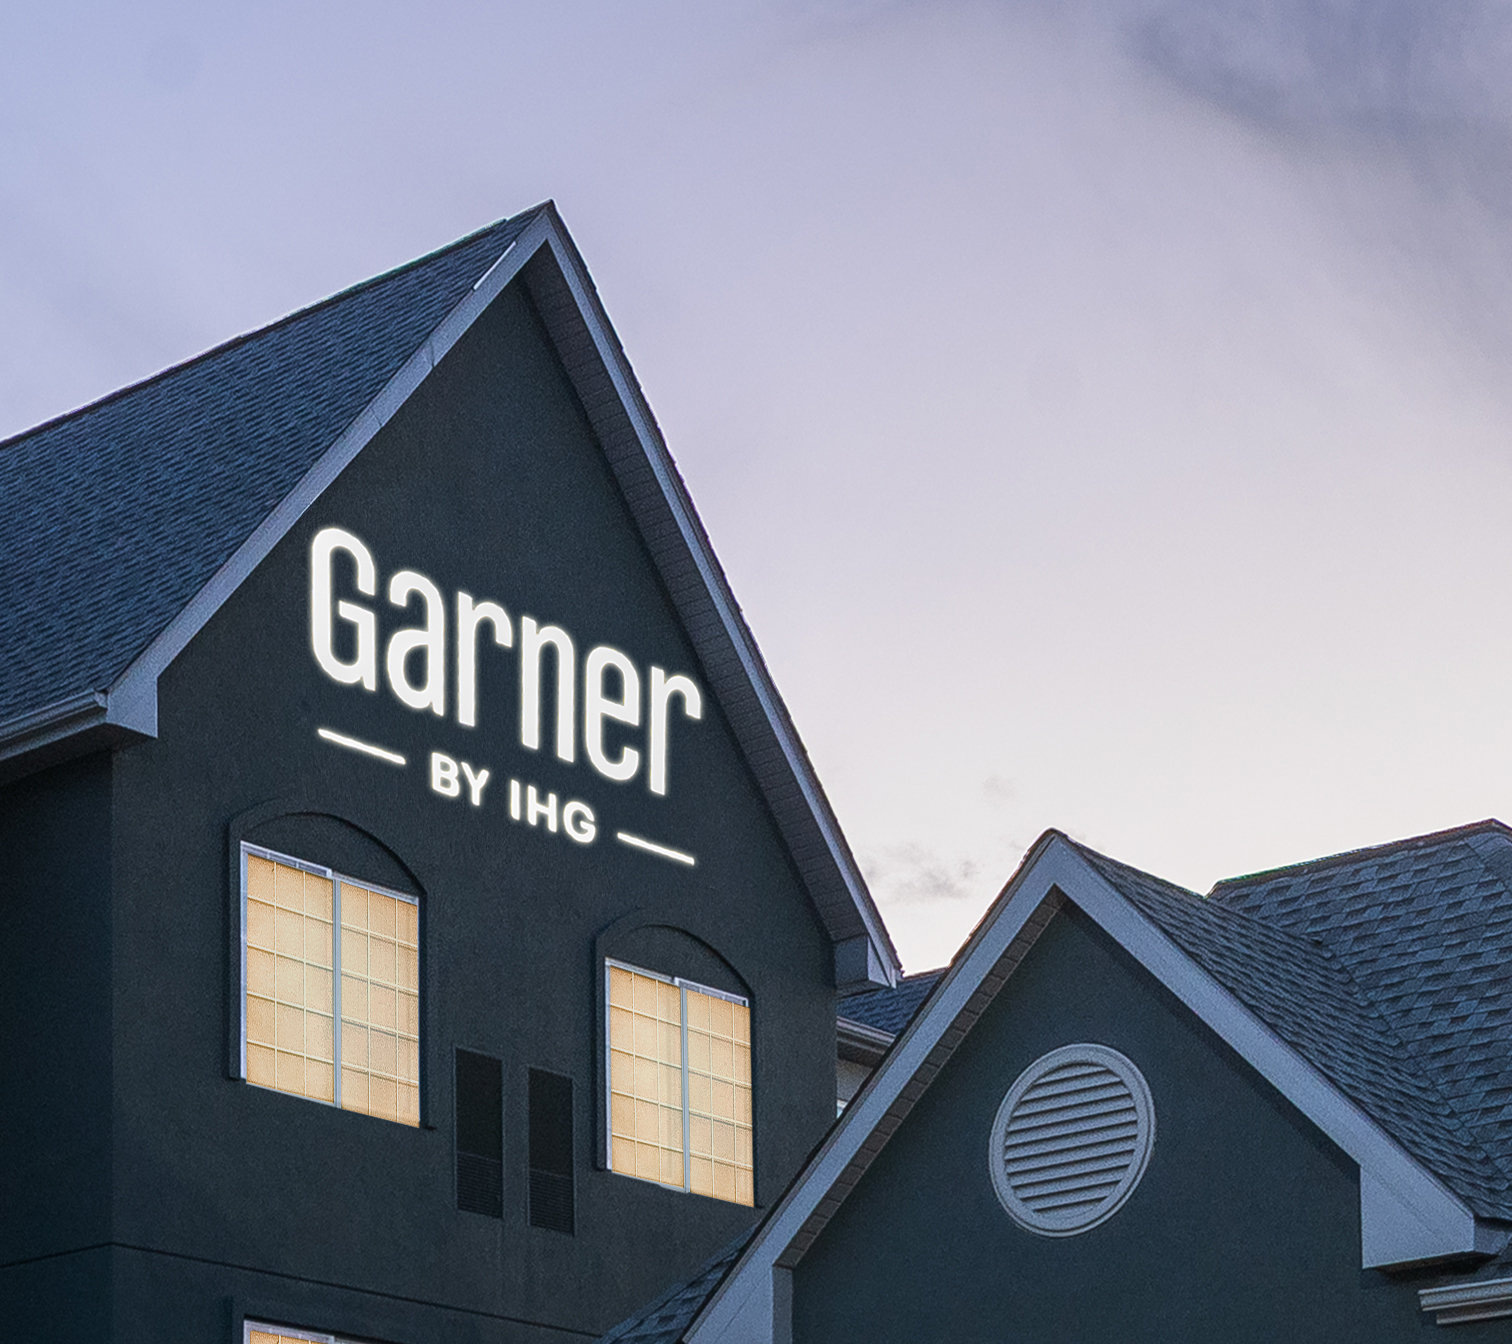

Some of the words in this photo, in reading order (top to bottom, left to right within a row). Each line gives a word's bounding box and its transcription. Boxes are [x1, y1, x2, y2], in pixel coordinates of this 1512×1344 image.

[311, 527, 702, 796] Garner
[430, 751, 490, 807] BY
[509, 778, 597, 844] IHG
